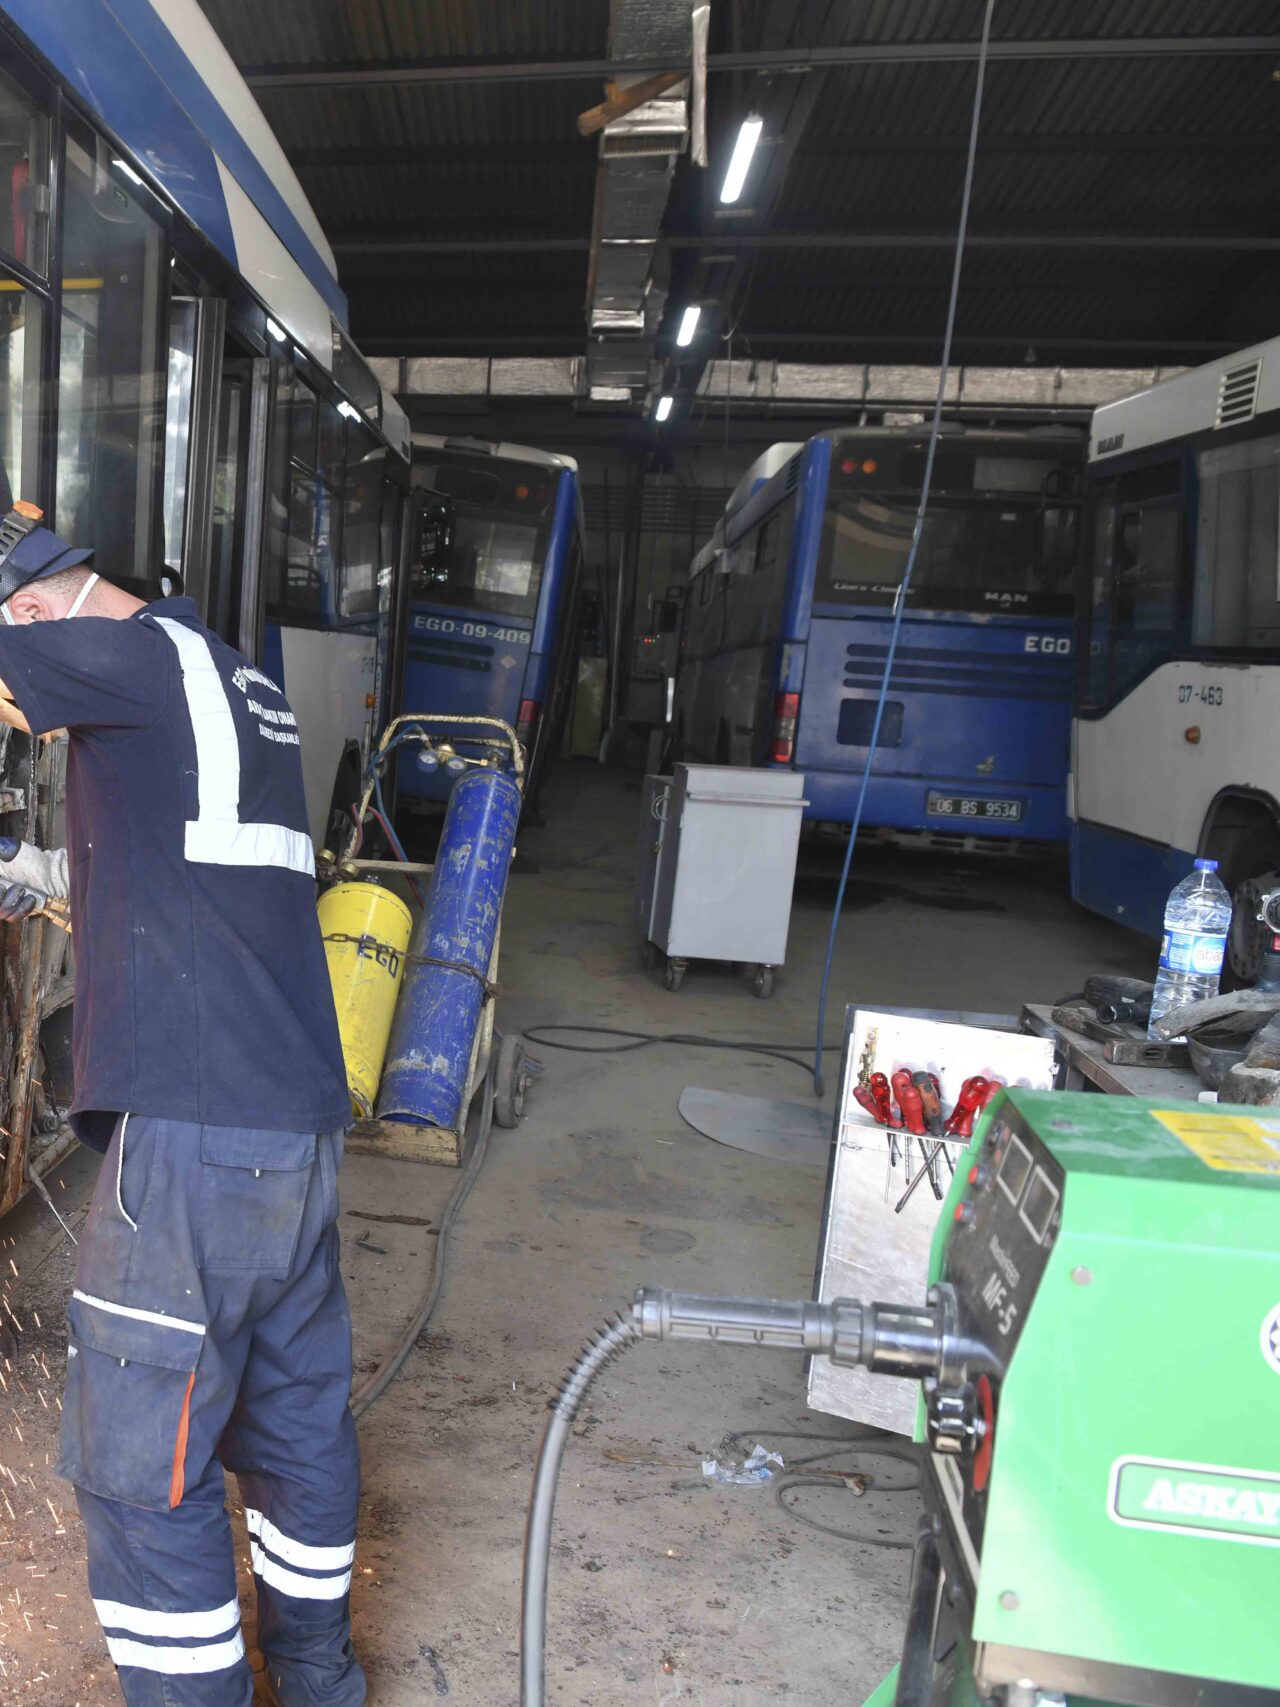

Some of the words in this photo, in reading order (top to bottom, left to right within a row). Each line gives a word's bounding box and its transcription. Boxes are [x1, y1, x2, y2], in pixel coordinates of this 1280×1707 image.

[985, 592, 1029, 603] MAN
[414, 616, 531, 645] EGO-09-409
[1024, 635, 1071, 655] EGO
[357, 934, 399, 979] EGO
[981, 1271, 1018, 1336] MF-5
